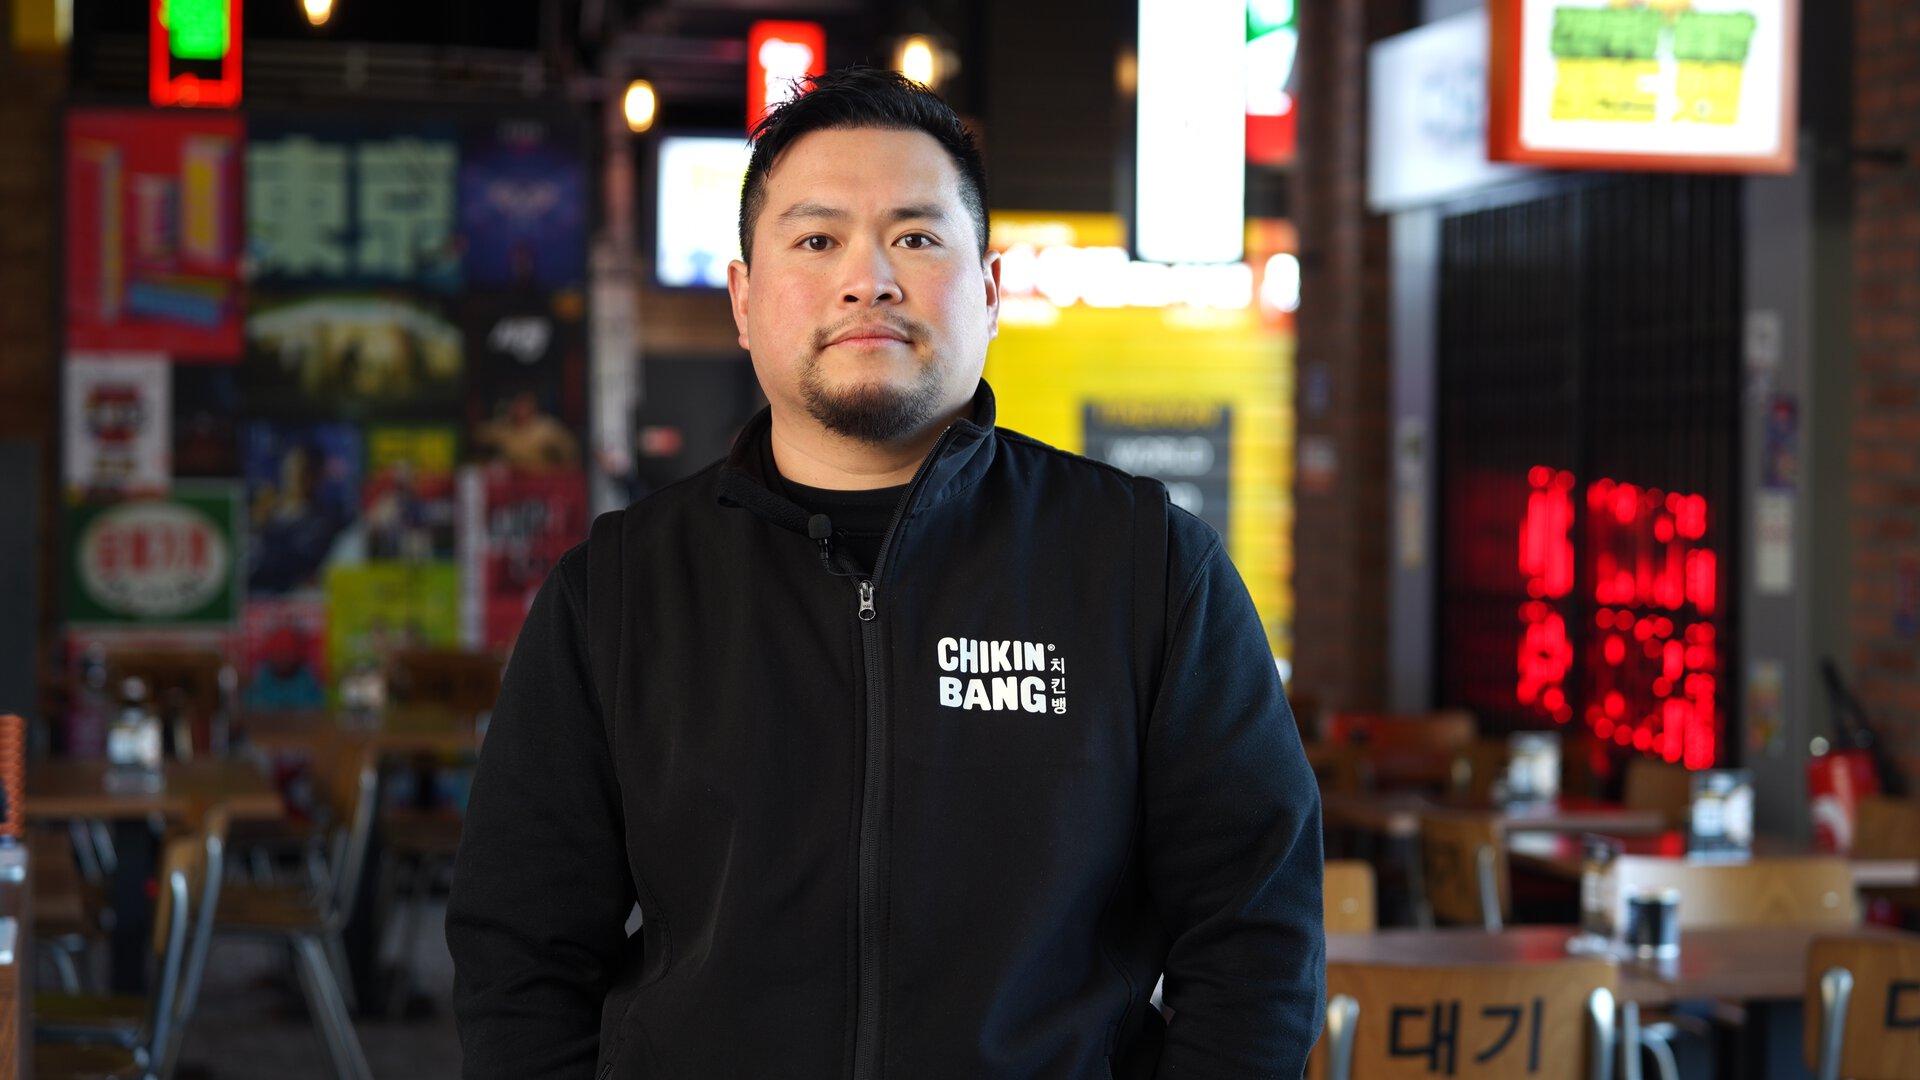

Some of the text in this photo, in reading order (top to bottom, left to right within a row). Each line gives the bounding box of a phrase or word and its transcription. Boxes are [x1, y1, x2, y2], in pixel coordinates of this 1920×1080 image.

[939, 676, 1047, 713] BANG
[1050, 657, 1067, 714] 치킨뱅
[1389, 998, 1545, 1077] 대기
